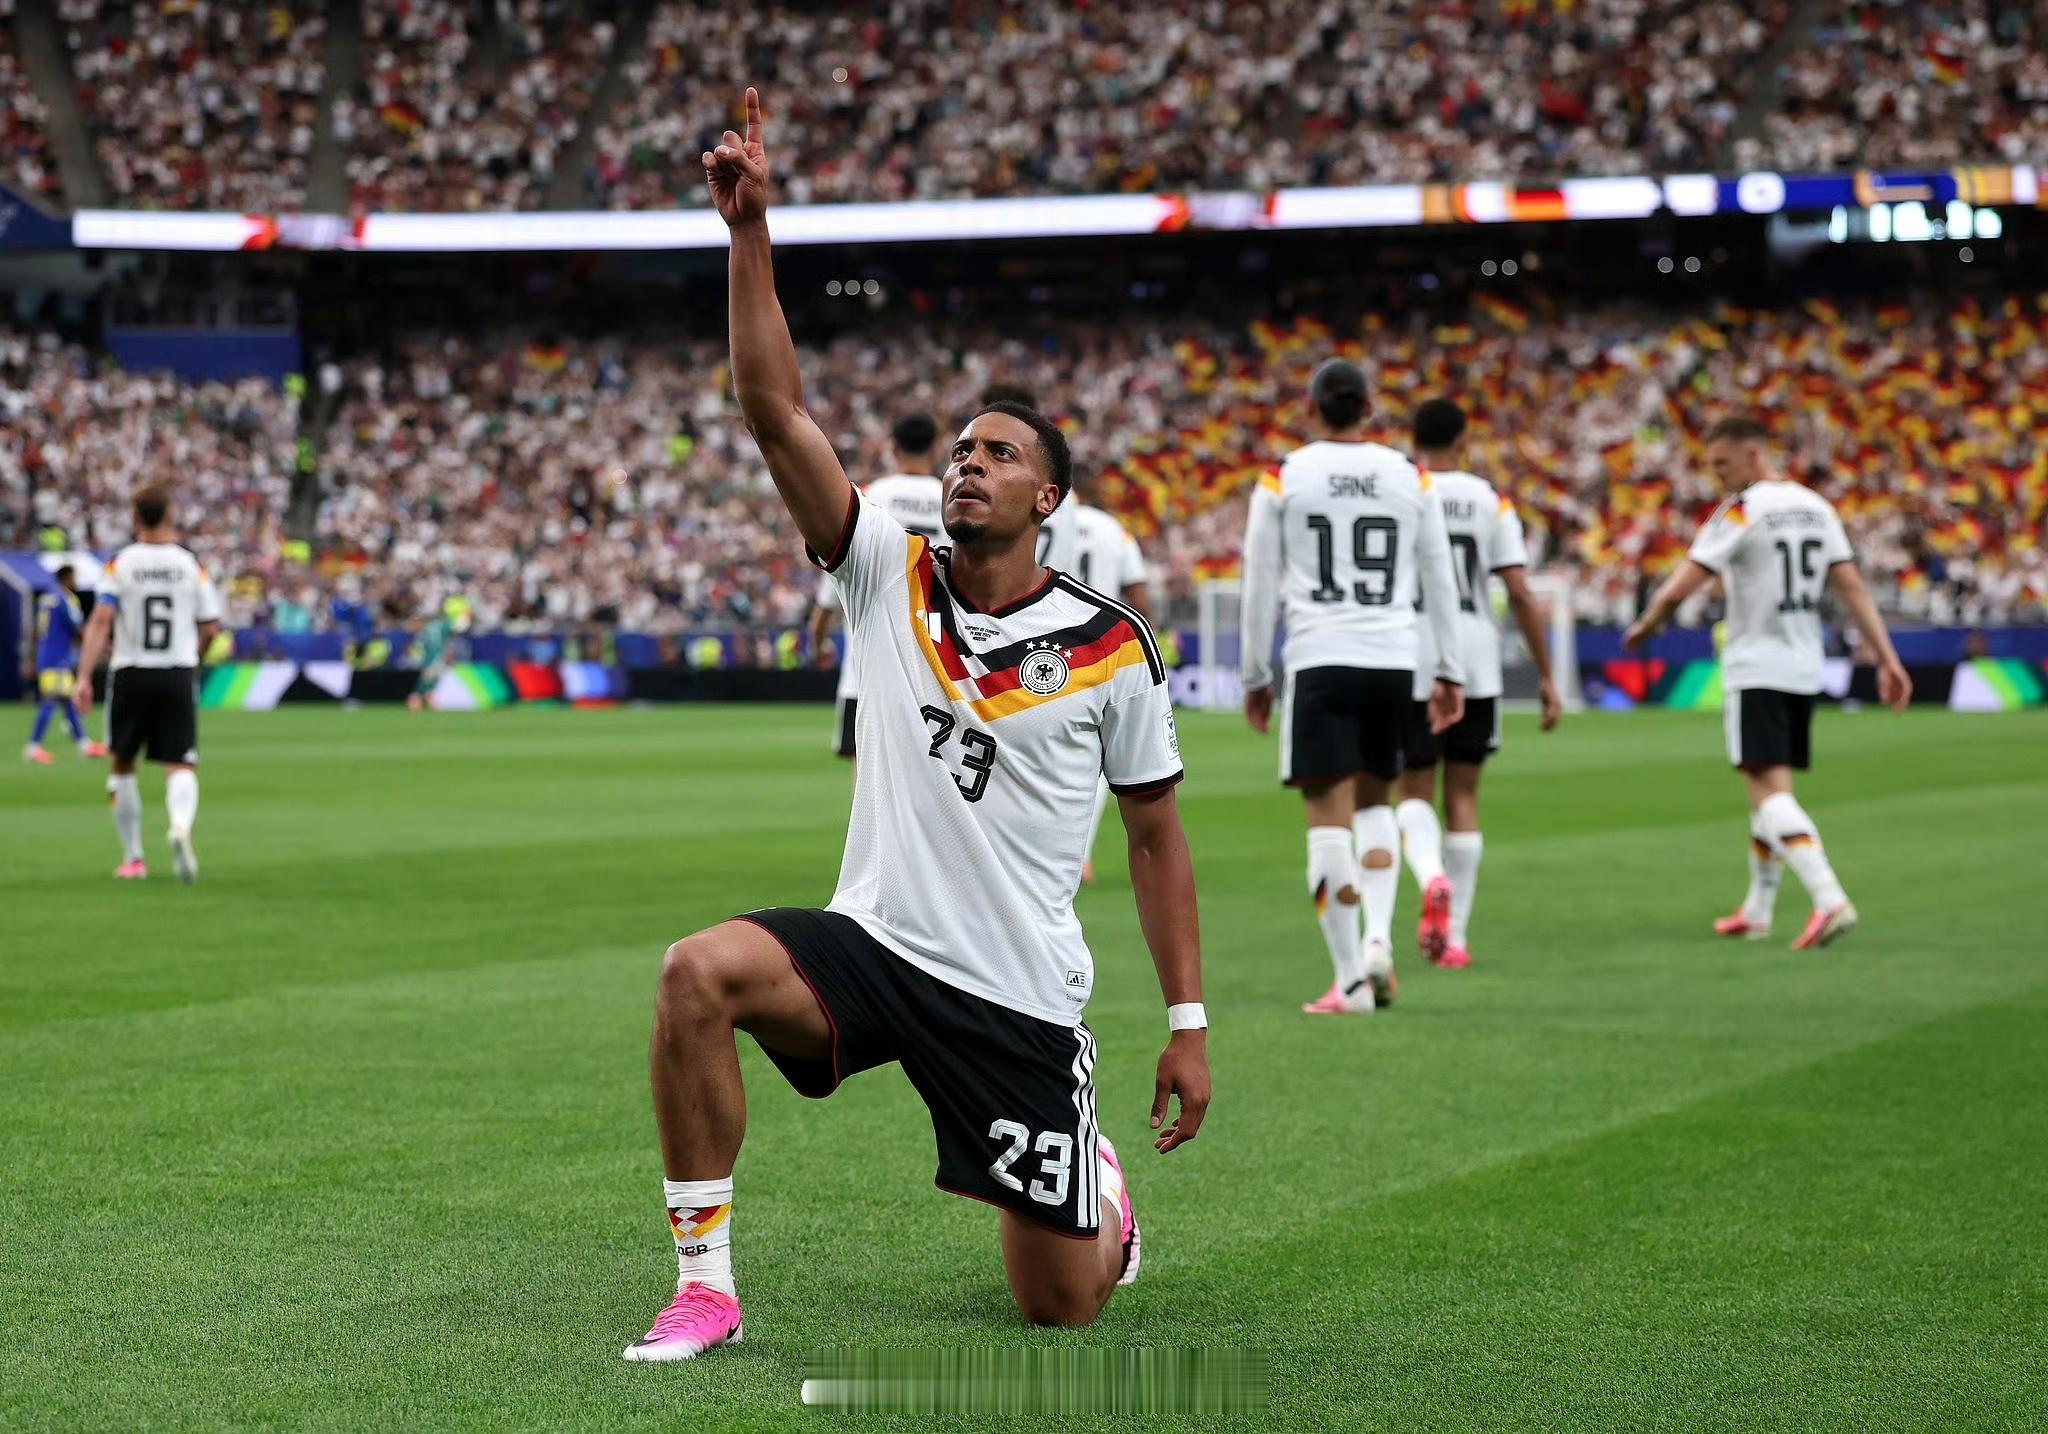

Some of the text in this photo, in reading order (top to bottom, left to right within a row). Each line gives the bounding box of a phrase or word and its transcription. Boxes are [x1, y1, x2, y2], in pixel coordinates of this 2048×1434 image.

[1329, 473, 1379, 499] SANÉ
[1307, 515, 1398, 606] 19
[144, 595, 172, 651] 6
[920, 704, 998, 804] 23
[988, 1118, 1074, 1207] 23
